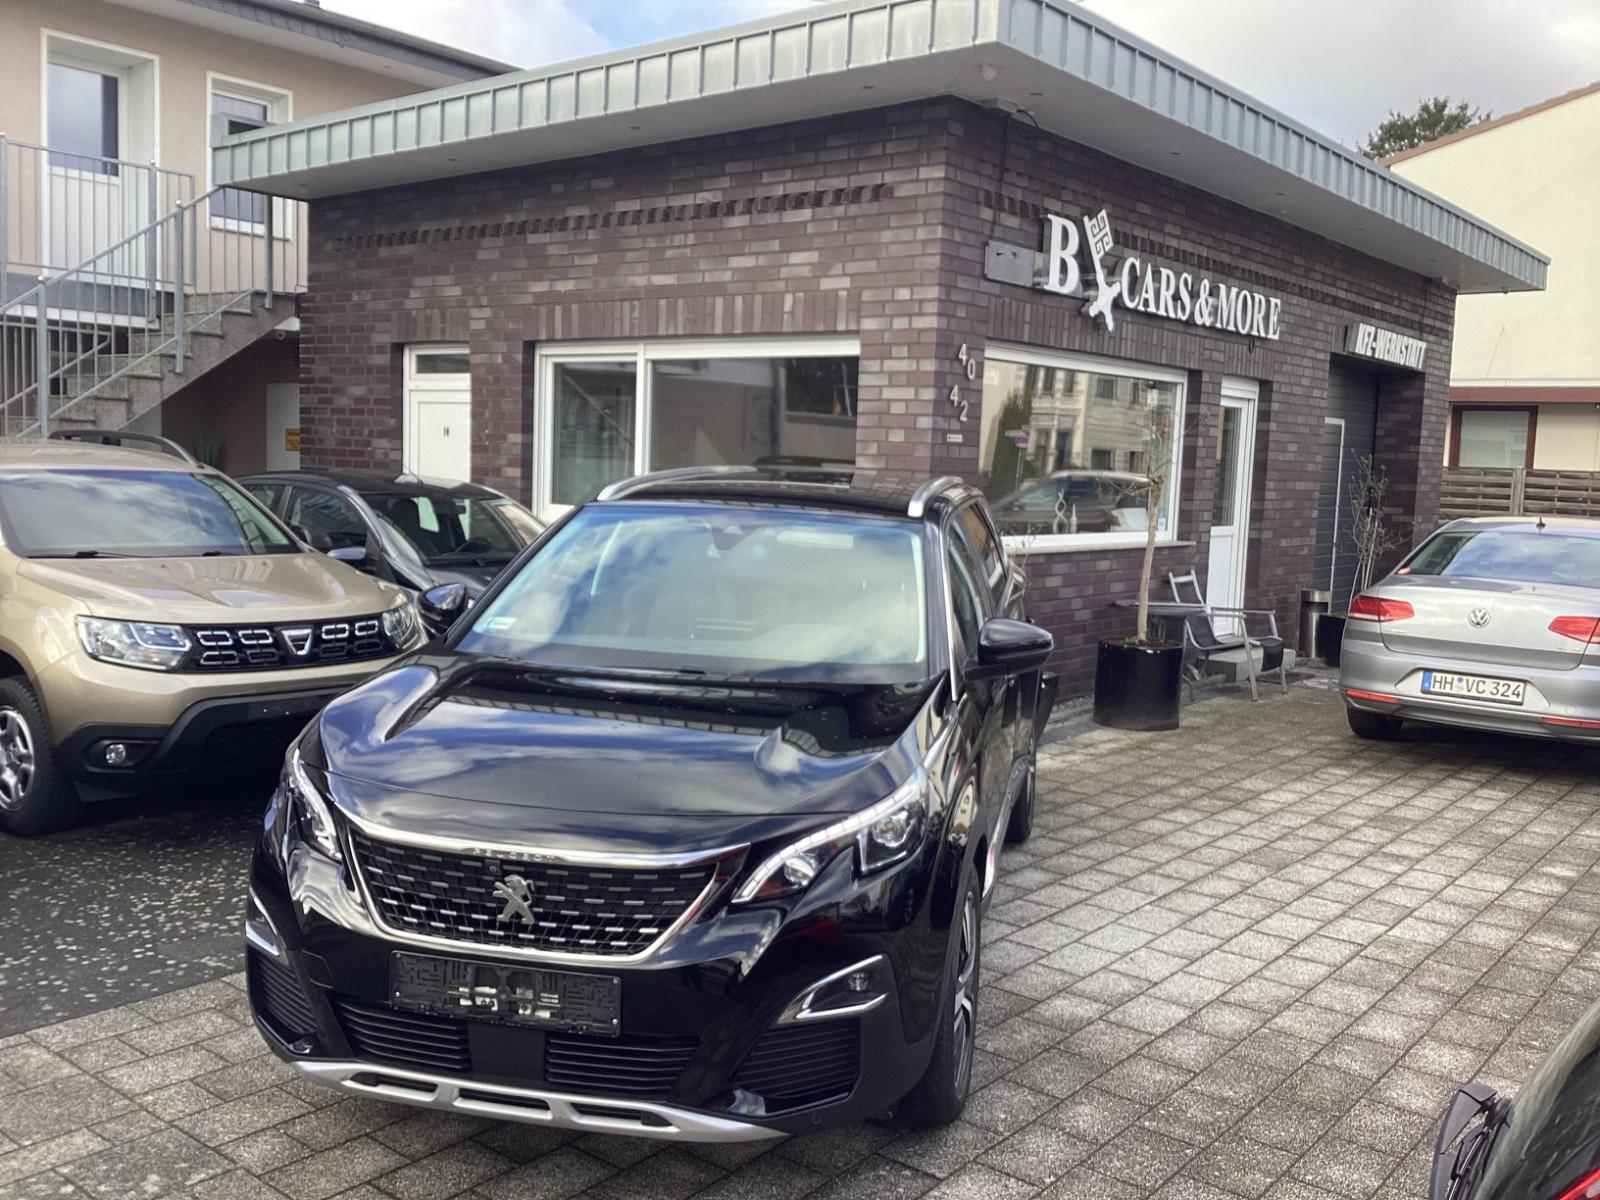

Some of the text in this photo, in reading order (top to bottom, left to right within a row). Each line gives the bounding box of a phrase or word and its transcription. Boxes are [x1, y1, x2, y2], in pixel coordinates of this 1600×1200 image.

[1043, 213, 1082, 296] B
[1355, 322, 1427, 370] KFZ-WERKSTATT
[1432, 674, 1521, 699] HH VC 324
